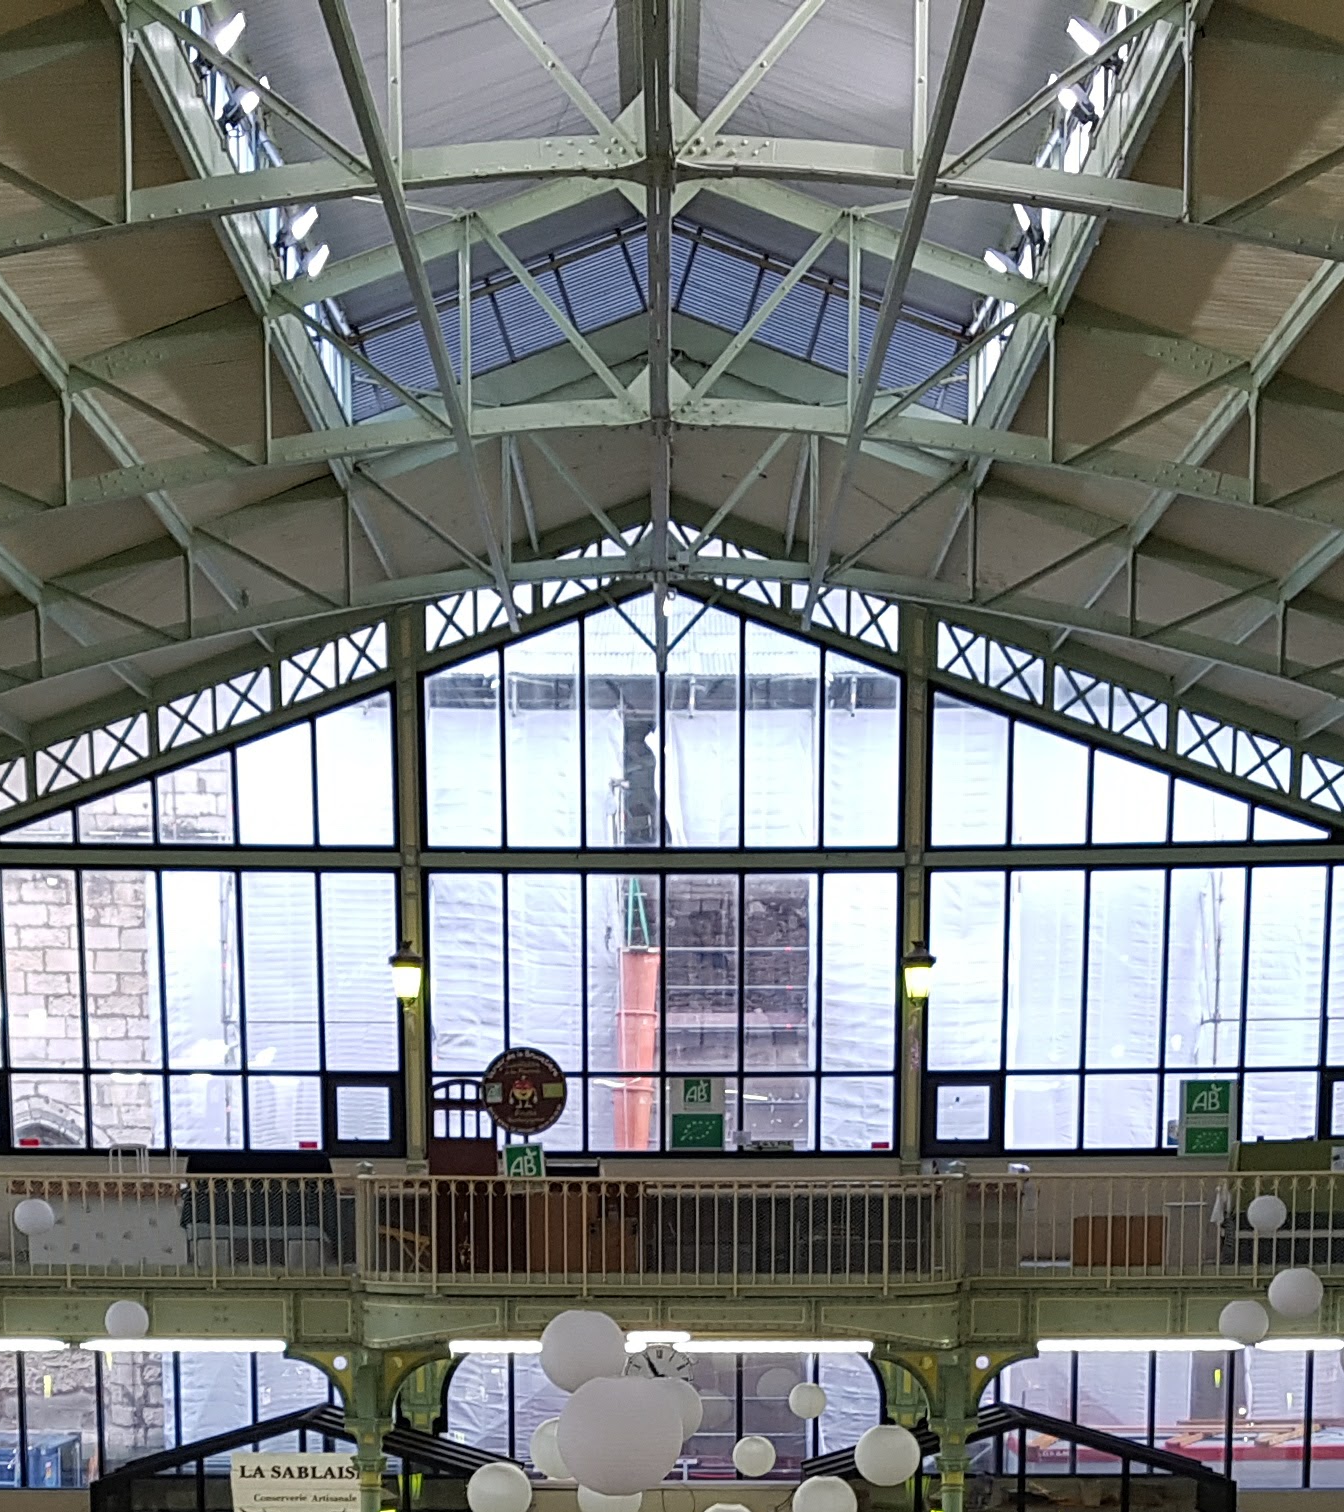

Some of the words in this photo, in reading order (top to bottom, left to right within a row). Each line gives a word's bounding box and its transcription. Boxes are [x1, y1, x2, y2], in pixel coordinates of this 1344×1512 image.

[686, 1084, 708, 1102] AB
[1192, 1090, 1220, 1111] AB
[510, 1155, 537, 1177] AB
[239, 1465, 265, 1479] LA
[270, 1465, 360, 1480] SABLAIS
